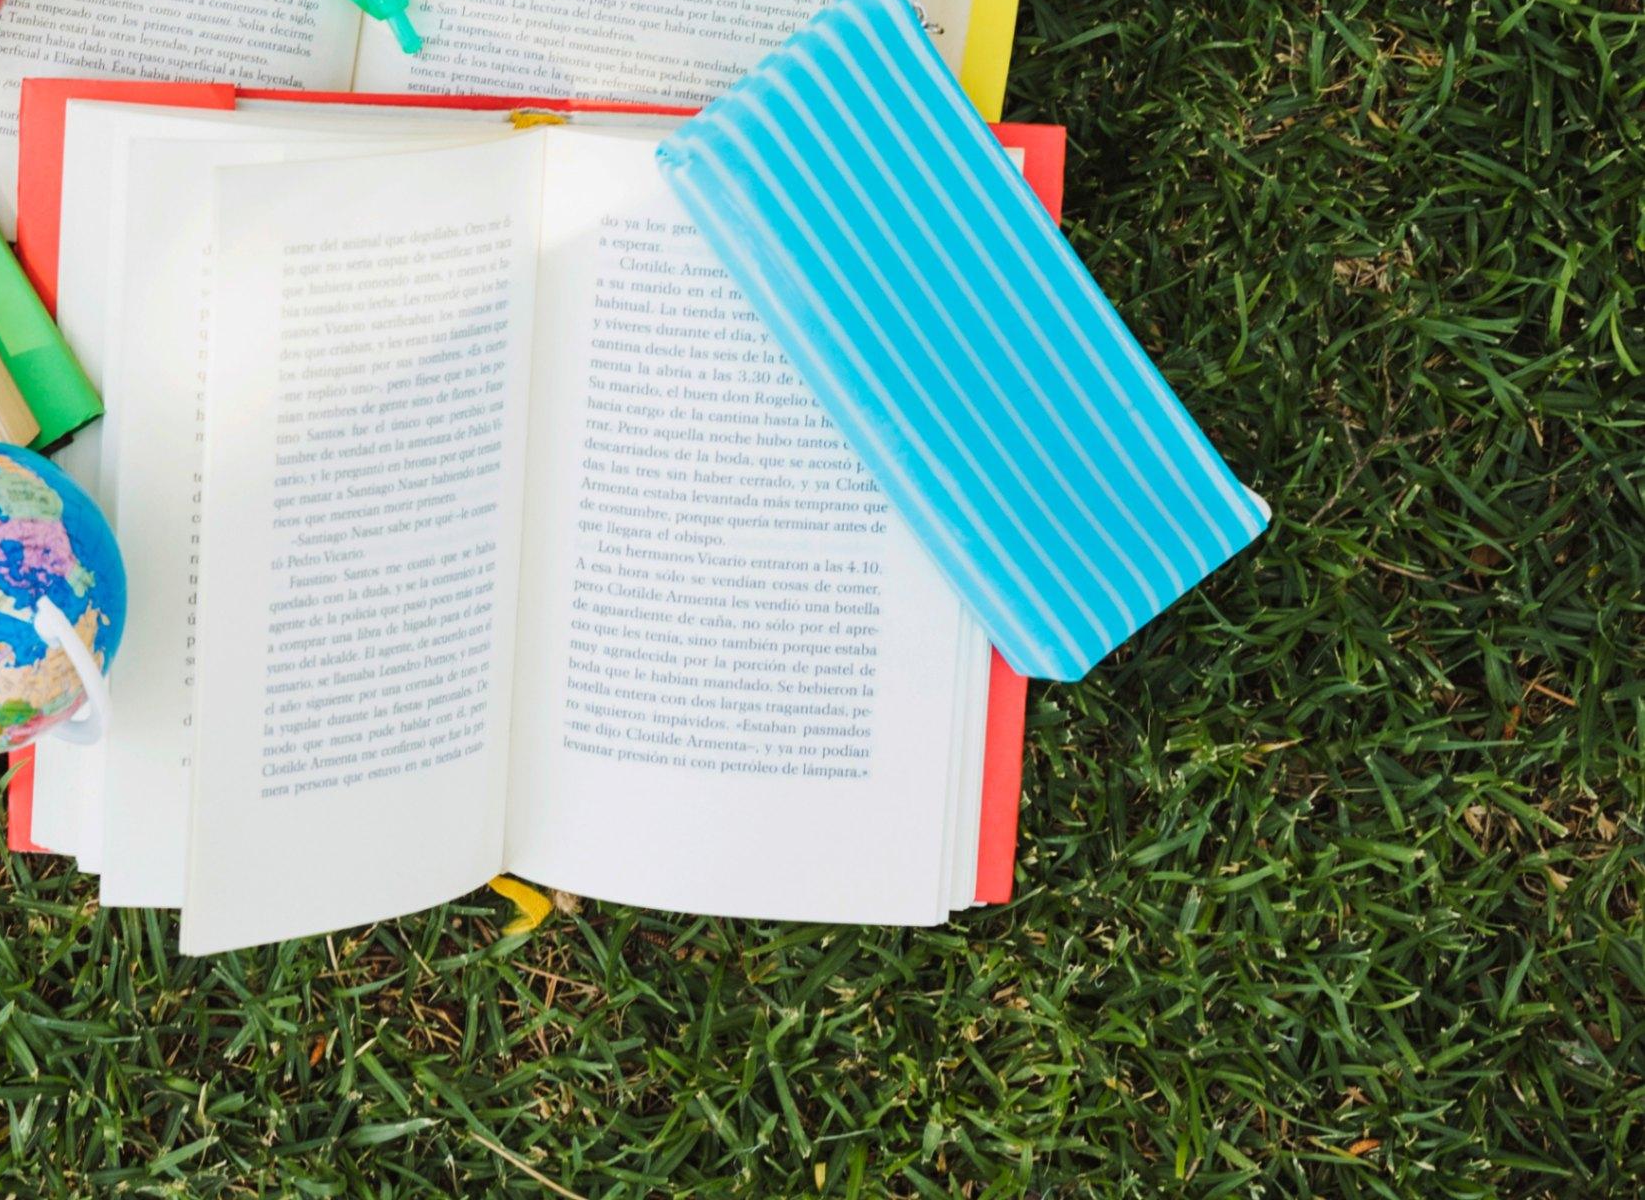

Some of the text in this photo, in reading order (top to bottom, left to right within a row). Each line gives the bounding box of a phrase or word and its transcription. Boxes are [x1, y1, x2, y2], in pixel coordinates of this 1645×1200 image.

[589, 358, 794, 385] menta la abría a las 3.30 de
[597, 539, 622, 555] Los
[624, 543, 695, 563] hermanos
[697, 550, 747, 567] Vicario
[750, 555, 809, 571] entraron
[812, 562, 821, 571] a
[824, 558, 843, 572] las
[575, 555, 587, 569] A
[590, 562, 612, 574] esa
[617, 562, 649, 579] hora
[654, 568, 685, 583] sólo
[690, 575, 705, 585] se
[711, 574, 766, 589] vendían
[771, 581, 809, 591] cosas
[814, 578, 832, 592] de
[562, 734, 613, 756] levantar
[616, 749, 669, 764] presión
[672, 753, 687, 766] ni
[689, 758, 716, 769] con
[719, 758, 778, 774] petróleo
[781, 761, 798, 774] de
